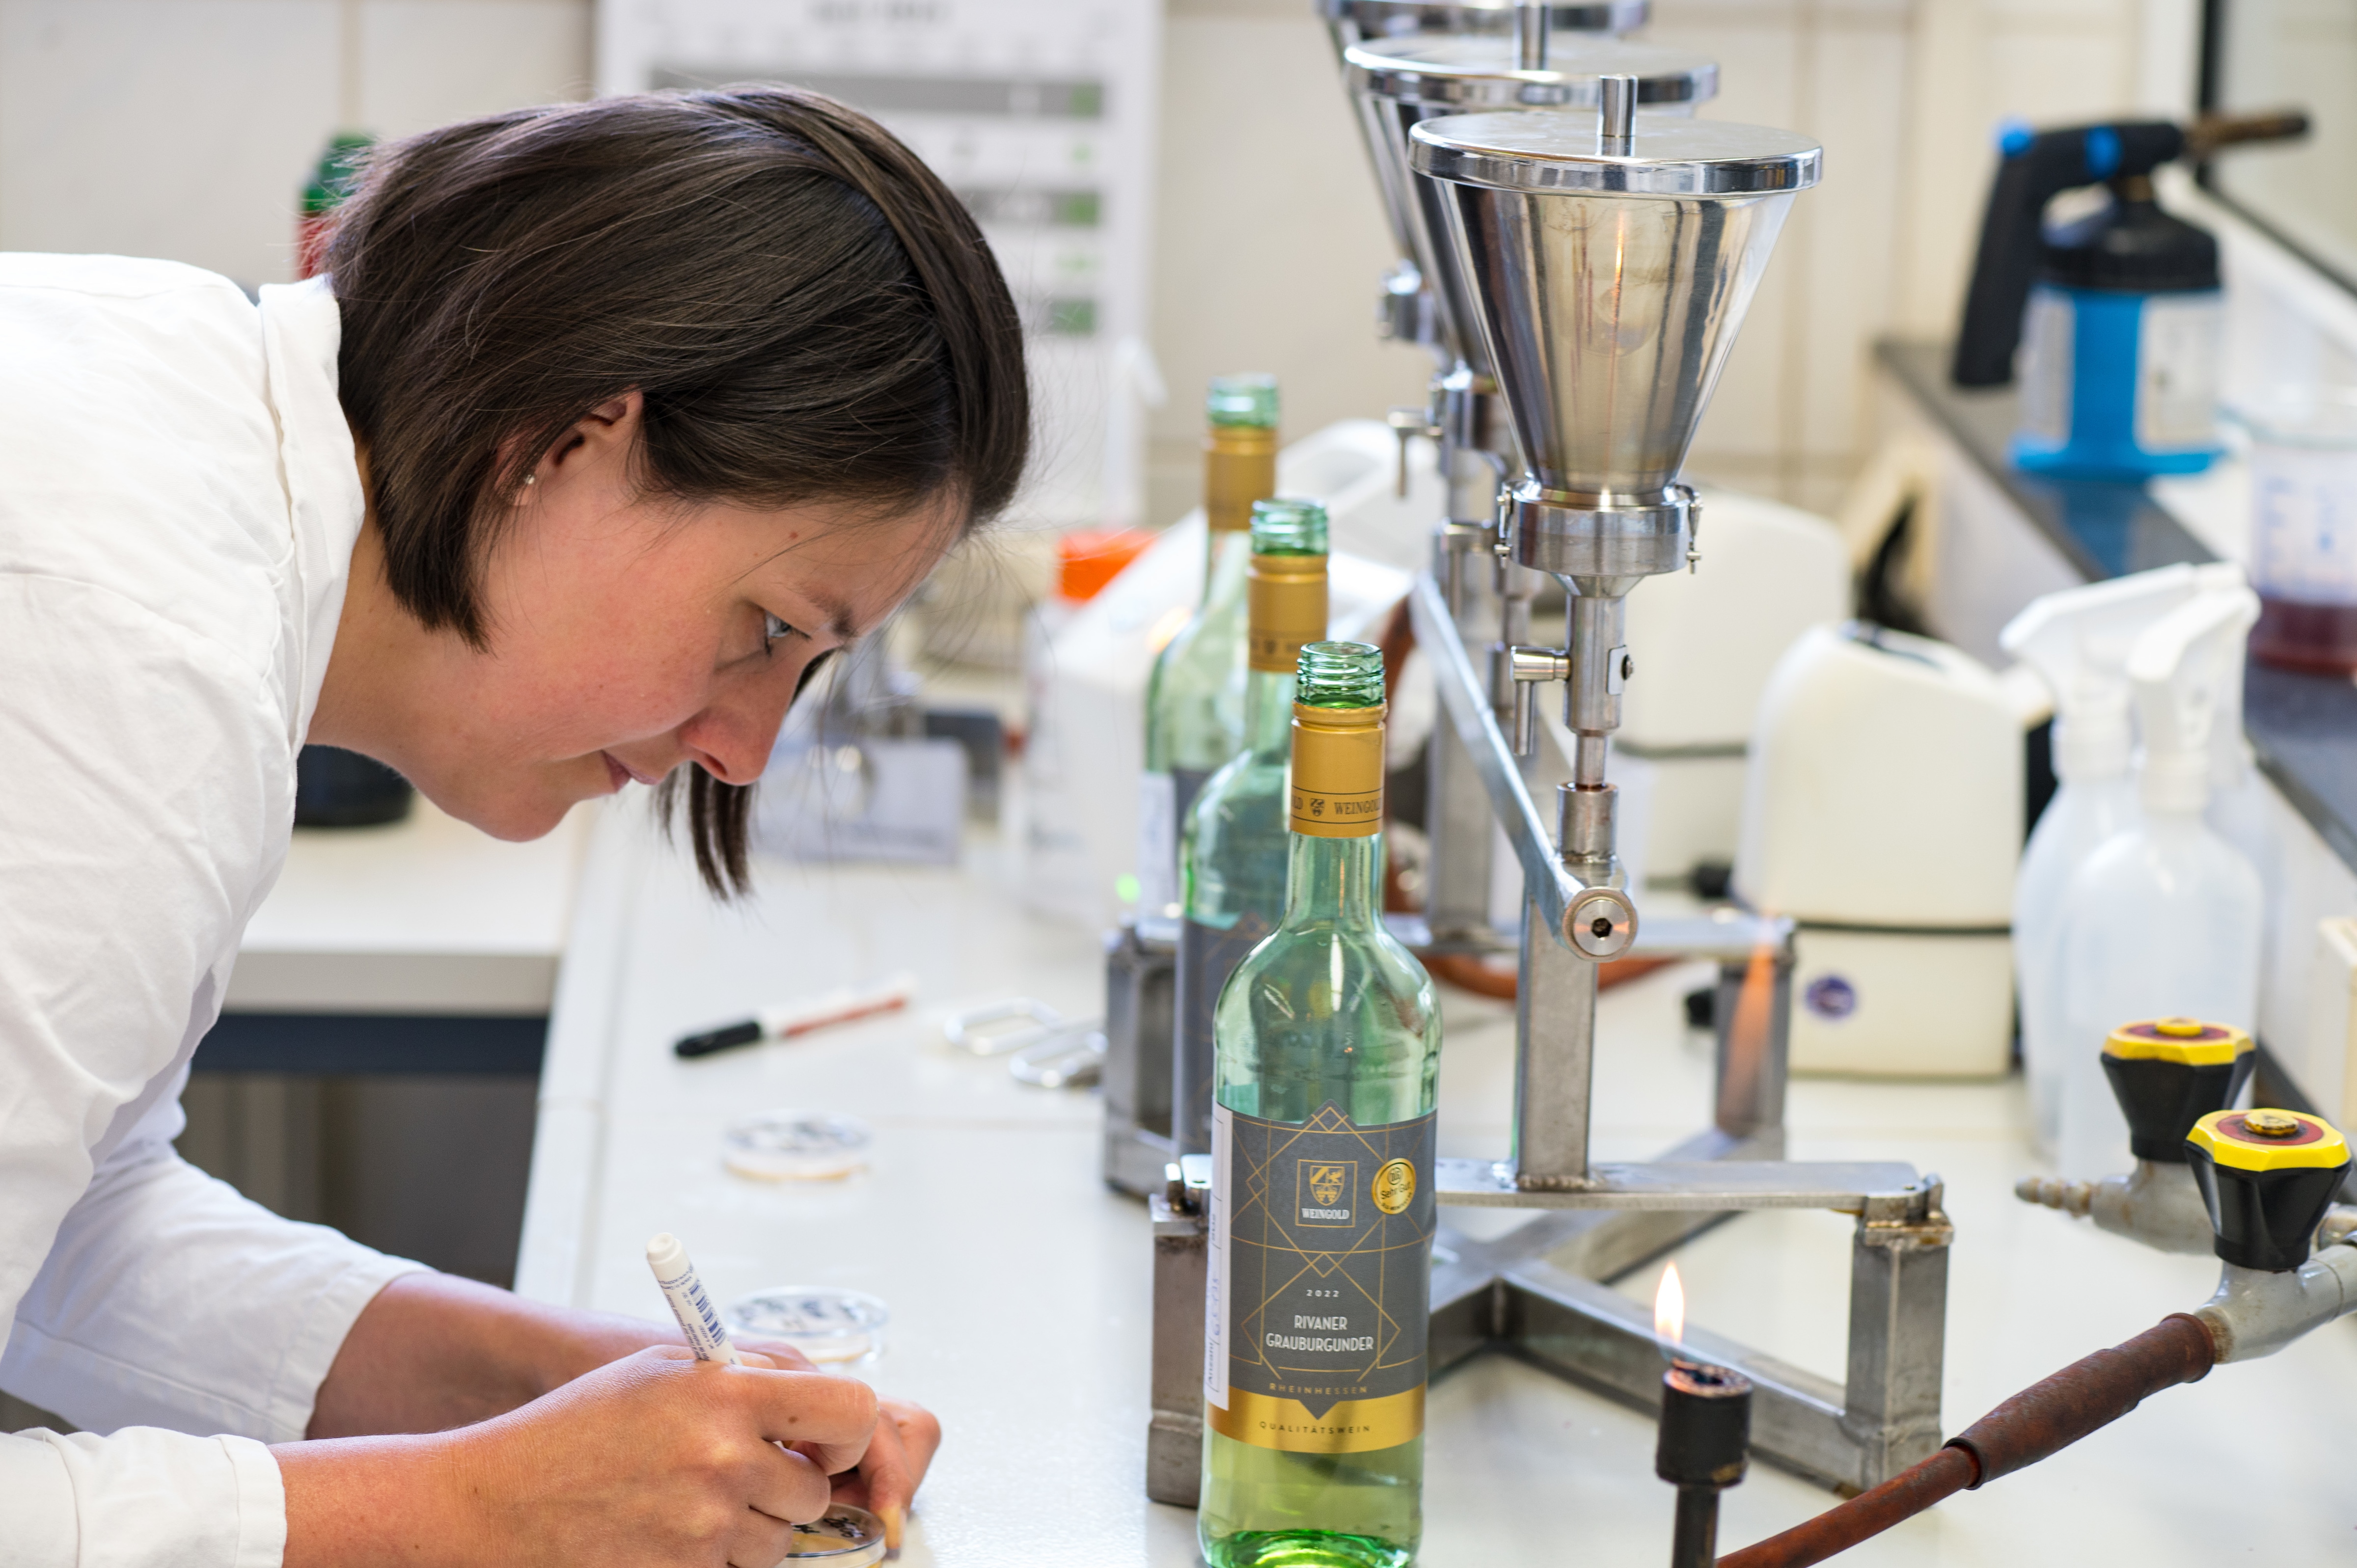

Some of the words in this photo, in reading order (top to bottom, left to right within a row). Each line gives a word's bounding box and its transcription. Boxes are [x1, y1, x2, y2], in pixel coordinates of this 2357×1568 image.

[1302, 1208, 1350, 1219] WEINGOLD
[1306, 1289, 1339, 1298] 2022
[1294, 1315, 1347, 1330] RIVANER
[1265, 1333, 1374, 1352] GRAUBURGUNDER
[1269, 1382, 1367, 1395] RHEINHESSEN
[1260, 1421, 1370, 1434] QUALITÄTSWEIN
